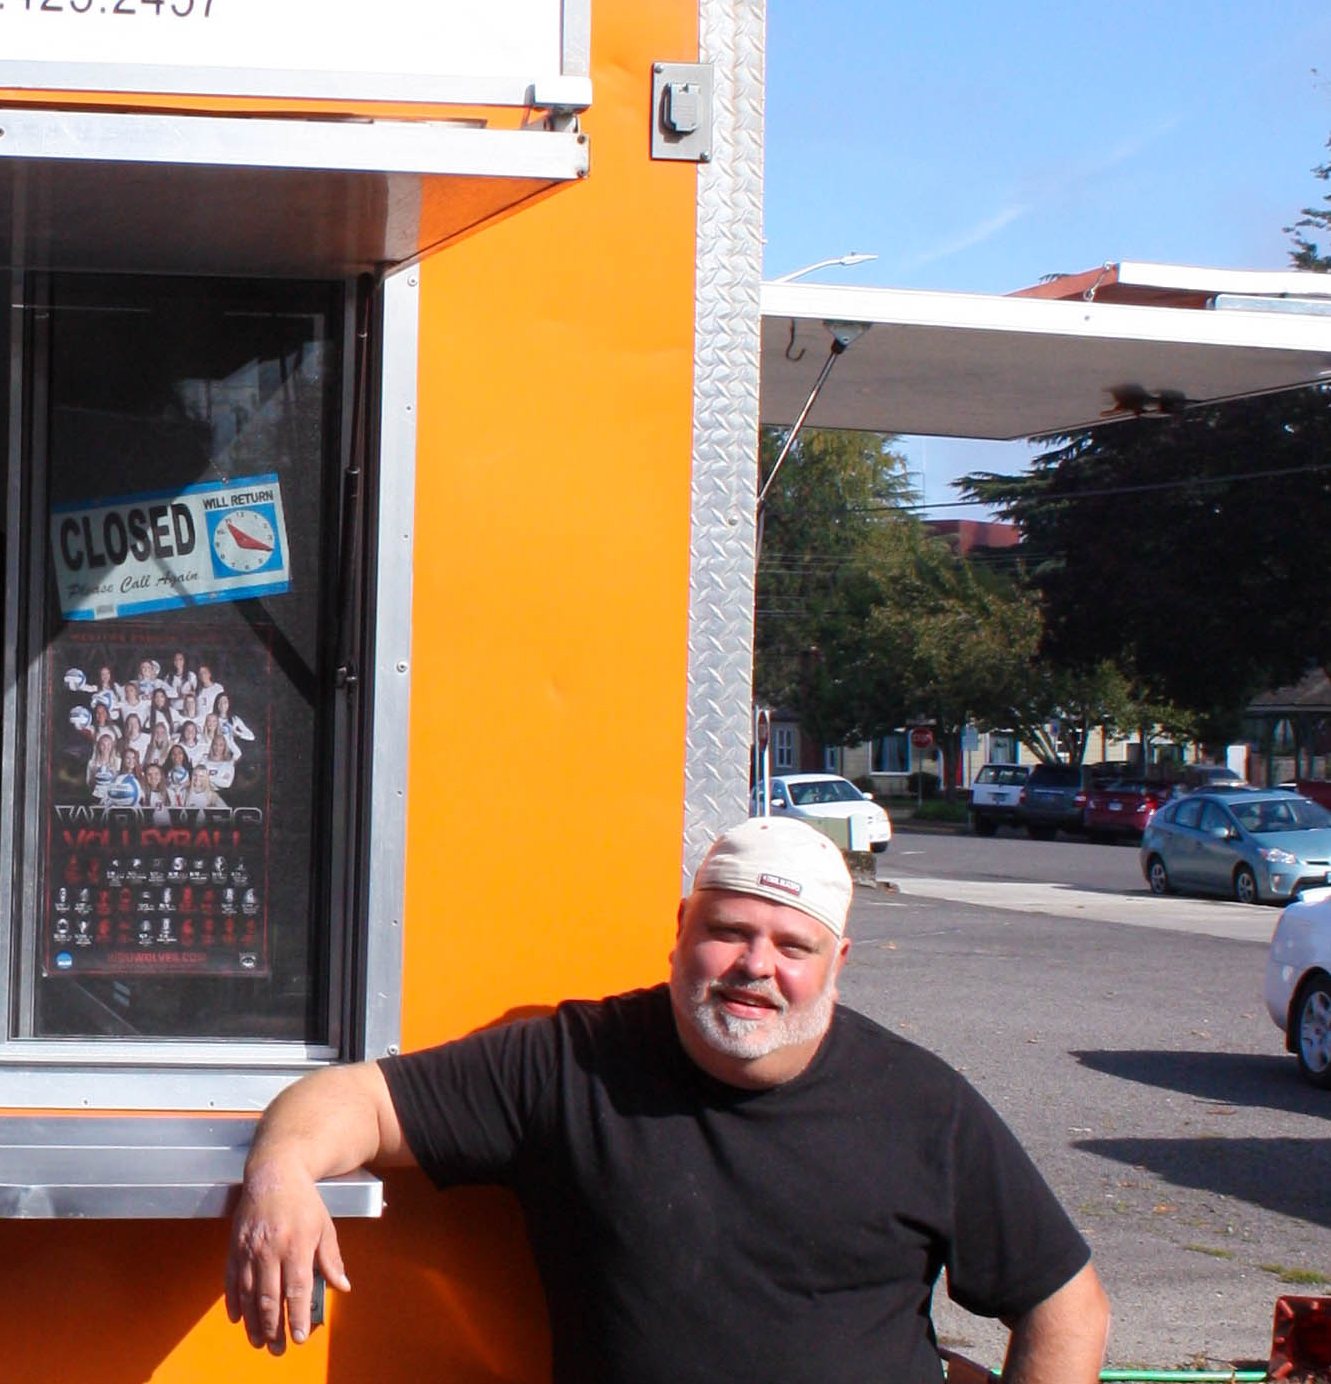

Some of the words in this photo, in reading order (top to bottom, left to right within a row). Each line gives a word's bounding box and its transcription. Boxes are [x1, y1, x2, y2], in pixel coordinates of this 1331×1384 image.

[202, 497, 229, 510] WILL
[231, 490, 274, 506] RETURN
[61, 503, 196, 571] CLOSED
[69, 582, 114, 599] Please
[120, 574, 151, 594] Call
[154, 570, 199, 588] Again
